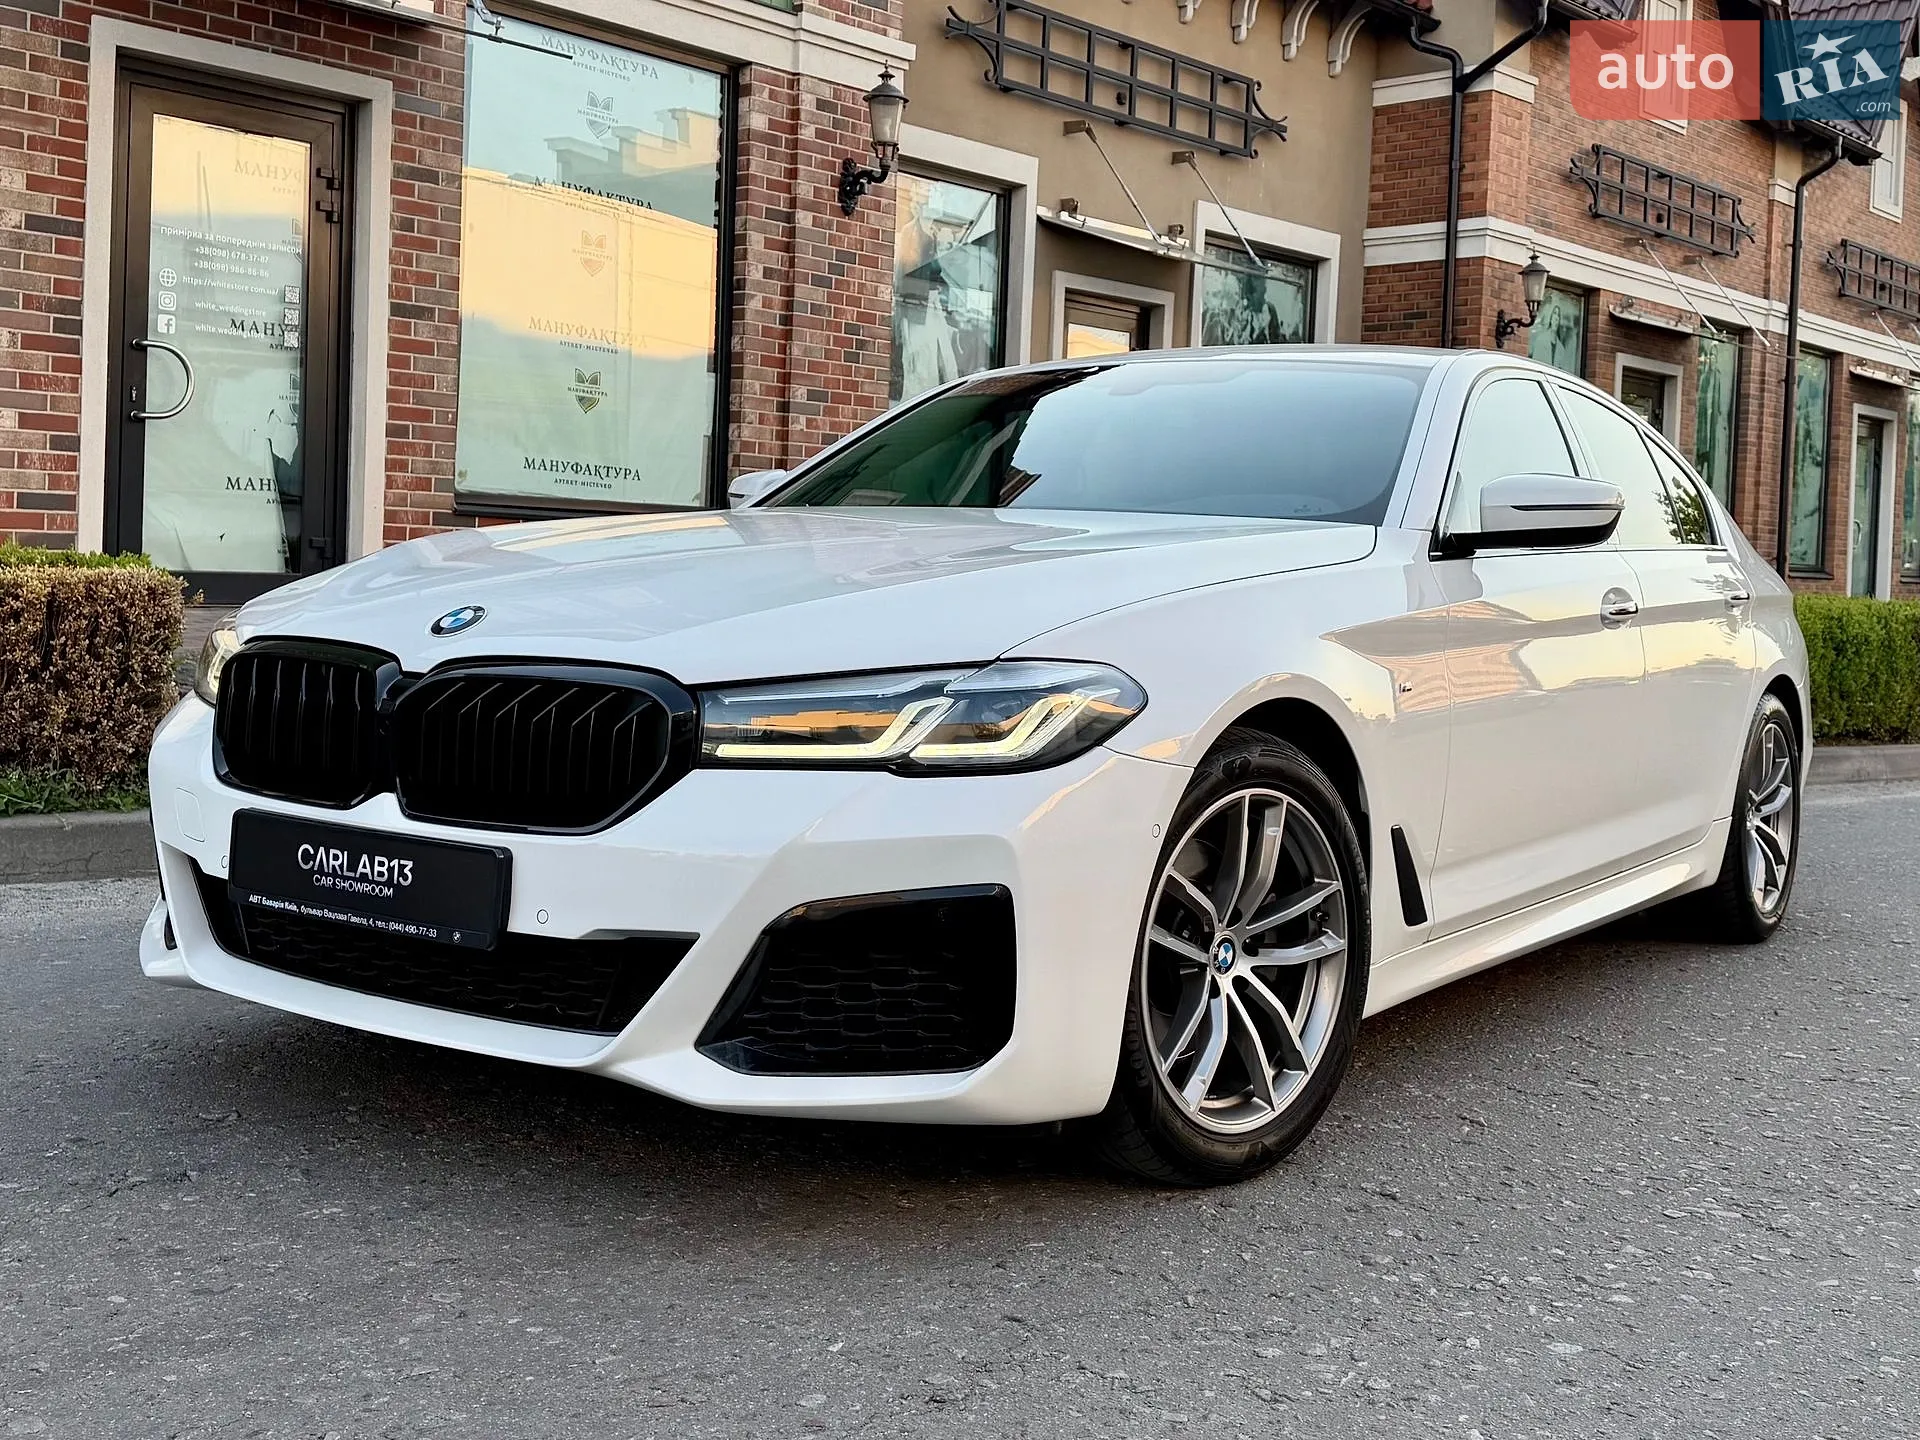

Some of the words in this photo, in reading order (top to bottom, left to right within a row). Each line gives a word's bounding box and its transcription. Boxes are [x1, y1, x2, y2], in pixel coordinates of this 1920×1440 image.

[541, 34, 659, 79] МАНУФАКТУРА
[528, 316, 648, 348] МАНУФАКТУРА
[523, 456, 641, 481] МАНУФАКТУРА
[297, 843, 413, 886] CARLAB13
[313, 874, 333, 889] CAR
[335, 878, 393, 898] SHOWROOM
[249, 894, 261, 904] АВТ
[389, 921, 404, 933] (044)
[405, 925, 437, 938] 490-77-33
